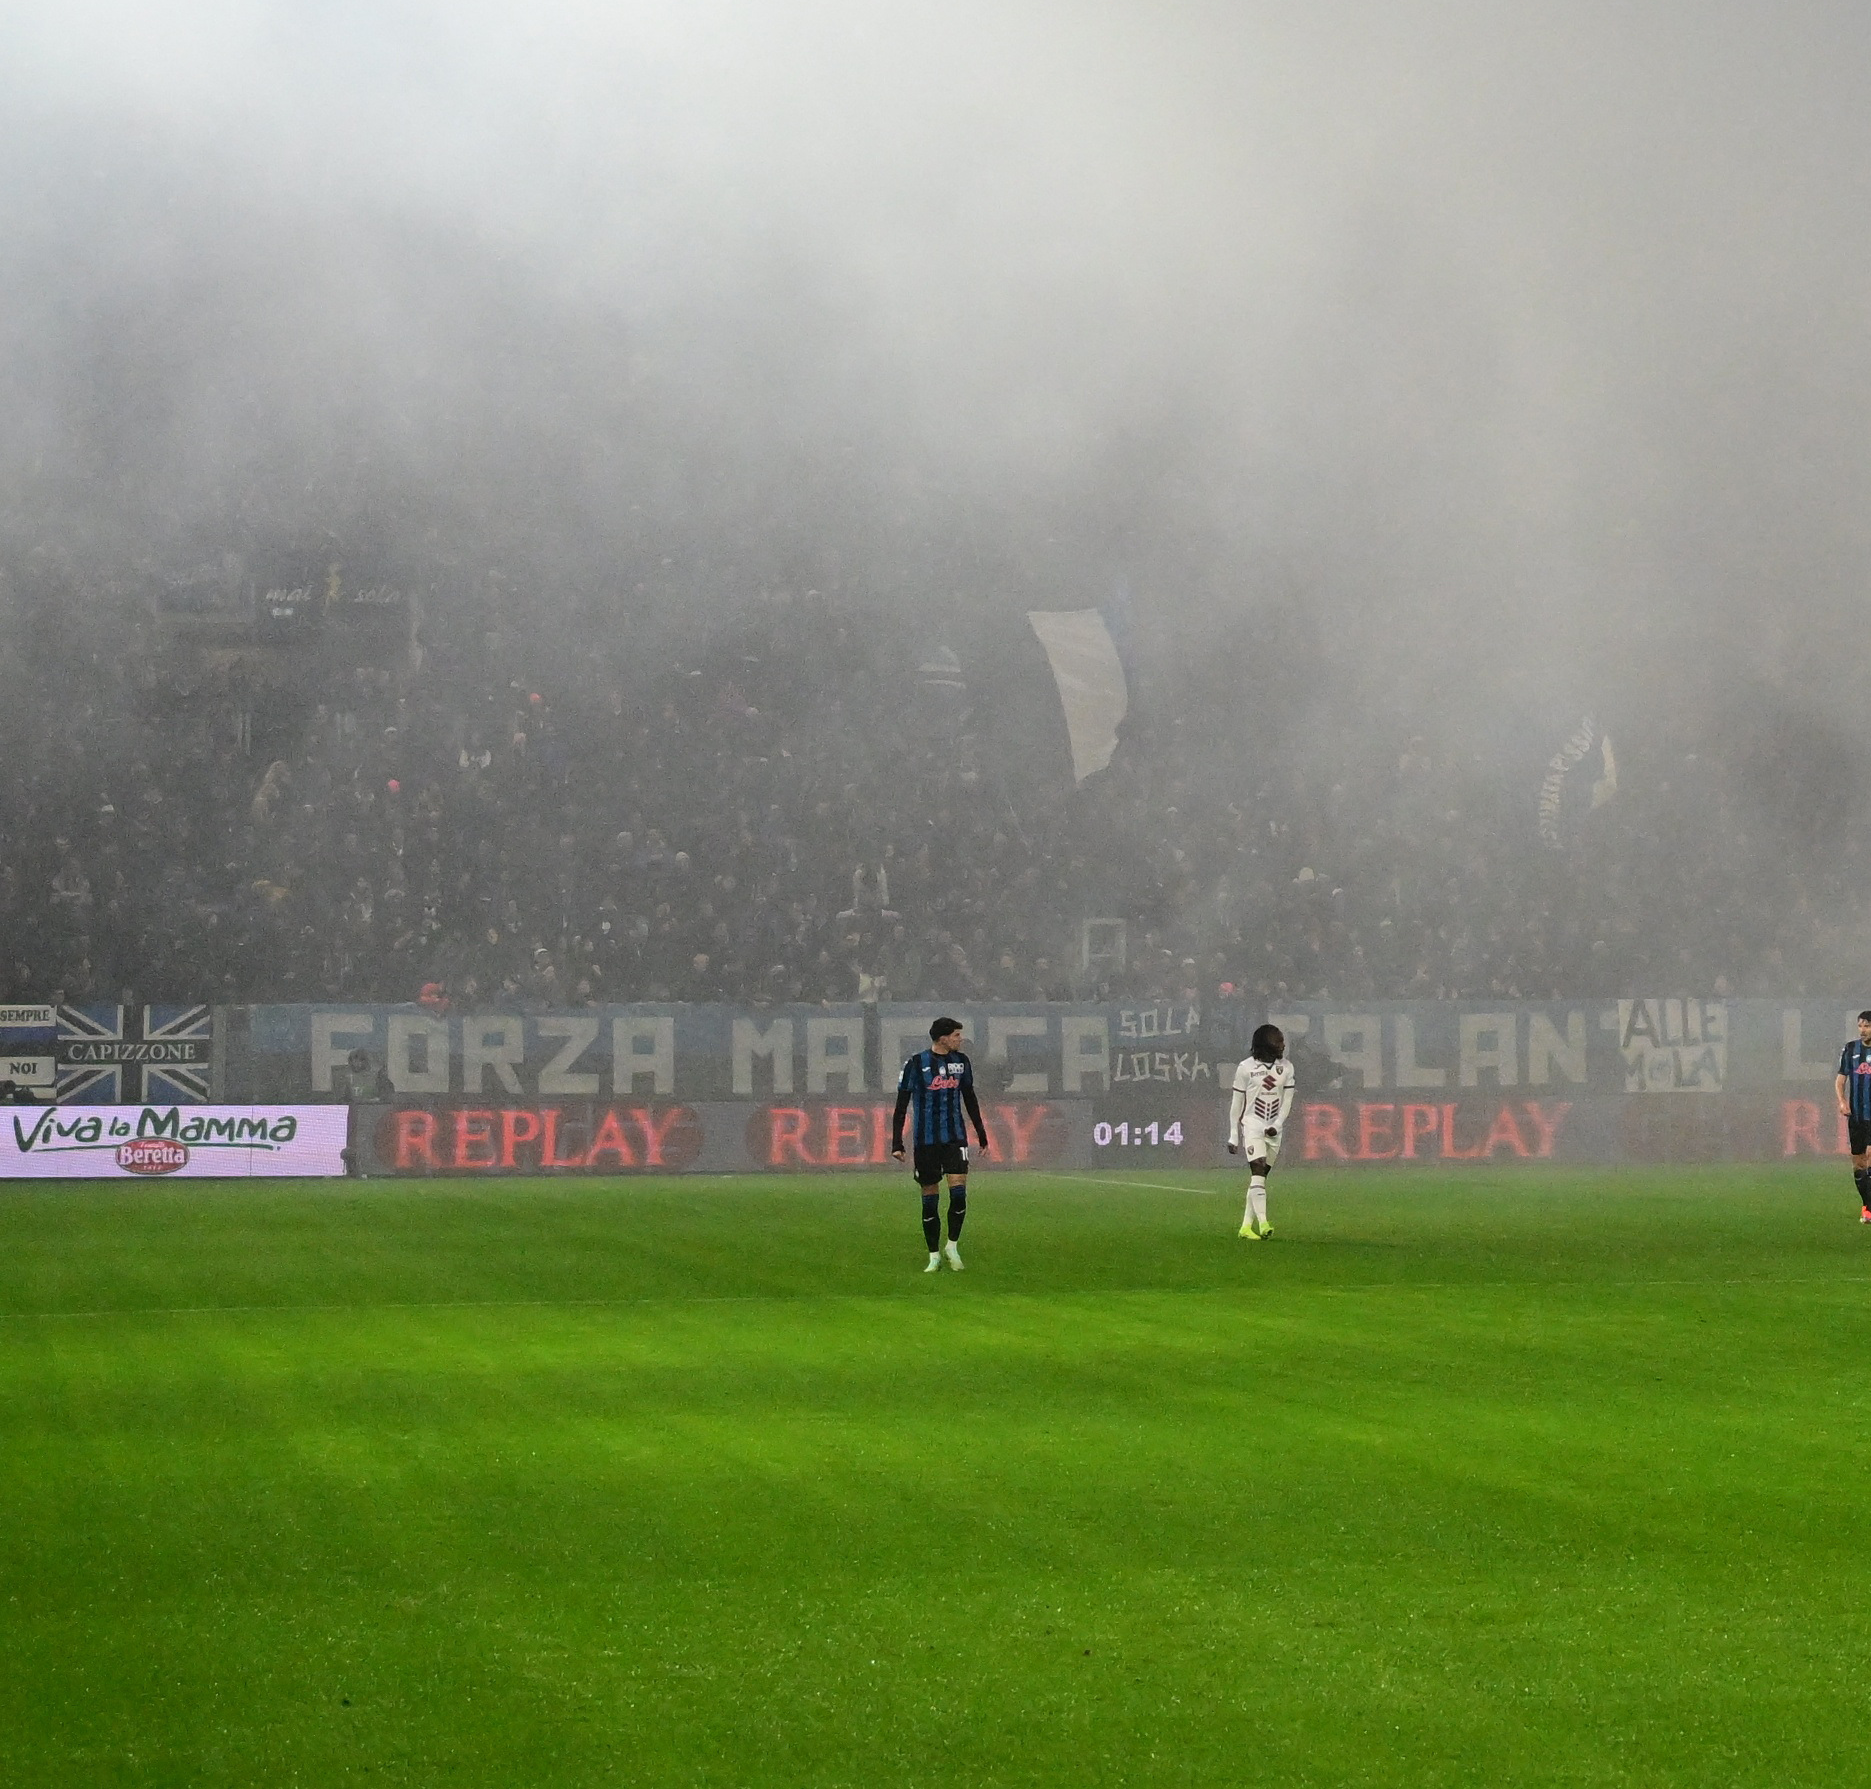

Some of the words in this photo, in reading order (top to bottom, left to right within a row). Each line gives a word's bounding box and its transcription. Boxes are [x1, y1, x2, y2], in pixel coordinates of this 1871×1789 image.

[0, 1009, 50, 1022] SEMPRE
[1119, 1006, 1200, 1038] SOLA
[9, 1062, 39, 1075] NOI
[67, 1043, 196, 1062] CAPIZZONE
[311, 1014, 675, 1095] FORZA
[732, 1015, 1111, 1094] MACA
[13, 1107, 102, 1153] Viva
[109, 1116, 131, 1137] la
[136, 1106, 297, 1142] Mamma
[392, 1105, 690, 1169] REPLAY
[767, 1104, 1049, 1166] REPY
[1093, 1121, 1184, 1146] 01:14
[1302, 1101, 1572, 1161] REPLAY
[120, 1146, 186, 1165] Beretta
